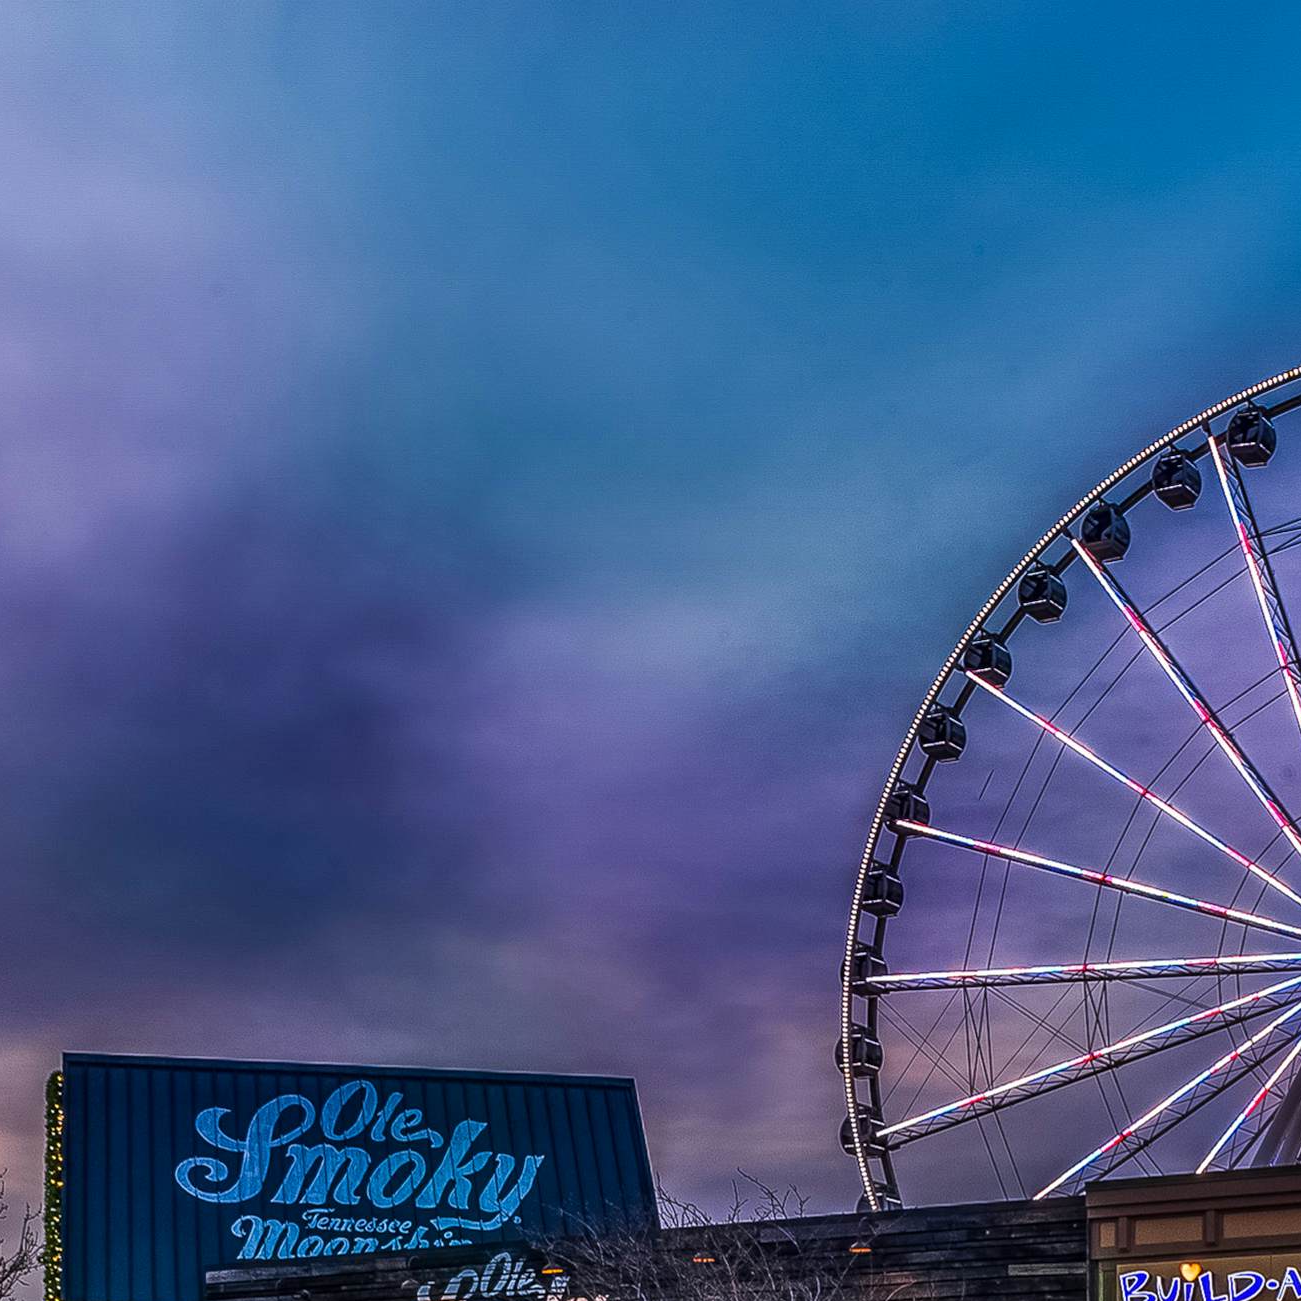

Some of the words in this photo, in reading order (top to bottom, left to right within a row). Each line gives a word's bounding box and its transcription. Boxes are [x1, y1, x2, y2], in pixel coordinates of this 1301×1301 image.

[320, 1079, 443, 1148] Ole
[175, 1094, 545, 1232] Smoky
[302, 1208, 413, 1233] Tennessee
[481, 1251, 546, 1298] Ole
